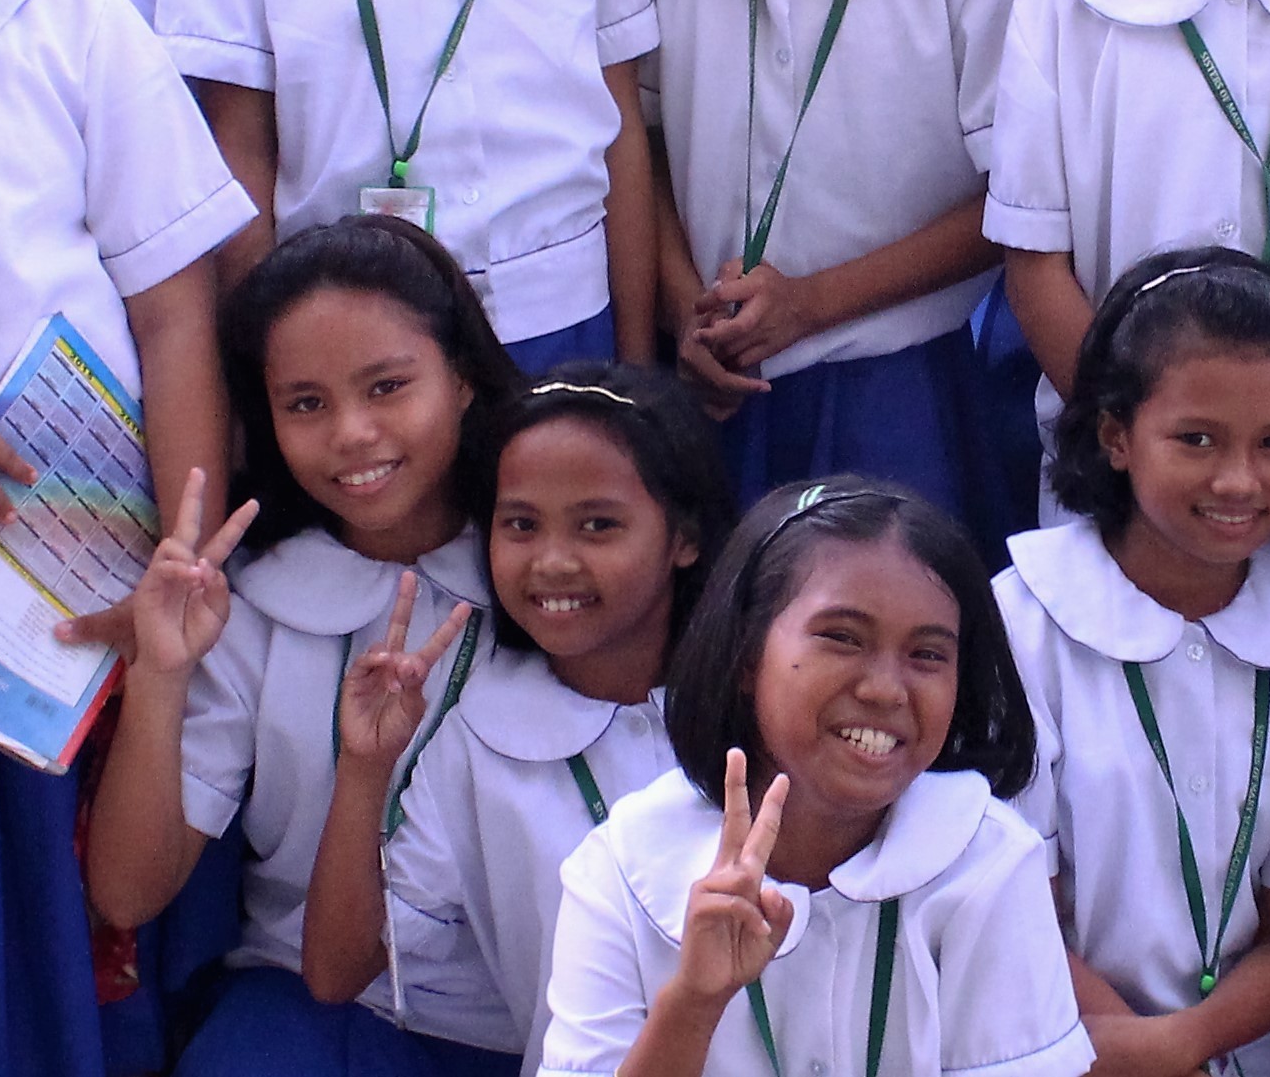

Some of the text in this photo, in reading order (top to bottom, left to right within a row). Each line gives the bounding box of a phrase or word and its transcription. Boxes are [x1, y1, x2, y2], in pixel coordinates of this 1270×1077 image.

[1198, 49, 1246, 131] SISTERS OF MARY
[1252, 723, 1265, 766] SISTERS
[1250, 766, 1260, 781] OF
[1244, 781, 1258, 814] MARY
